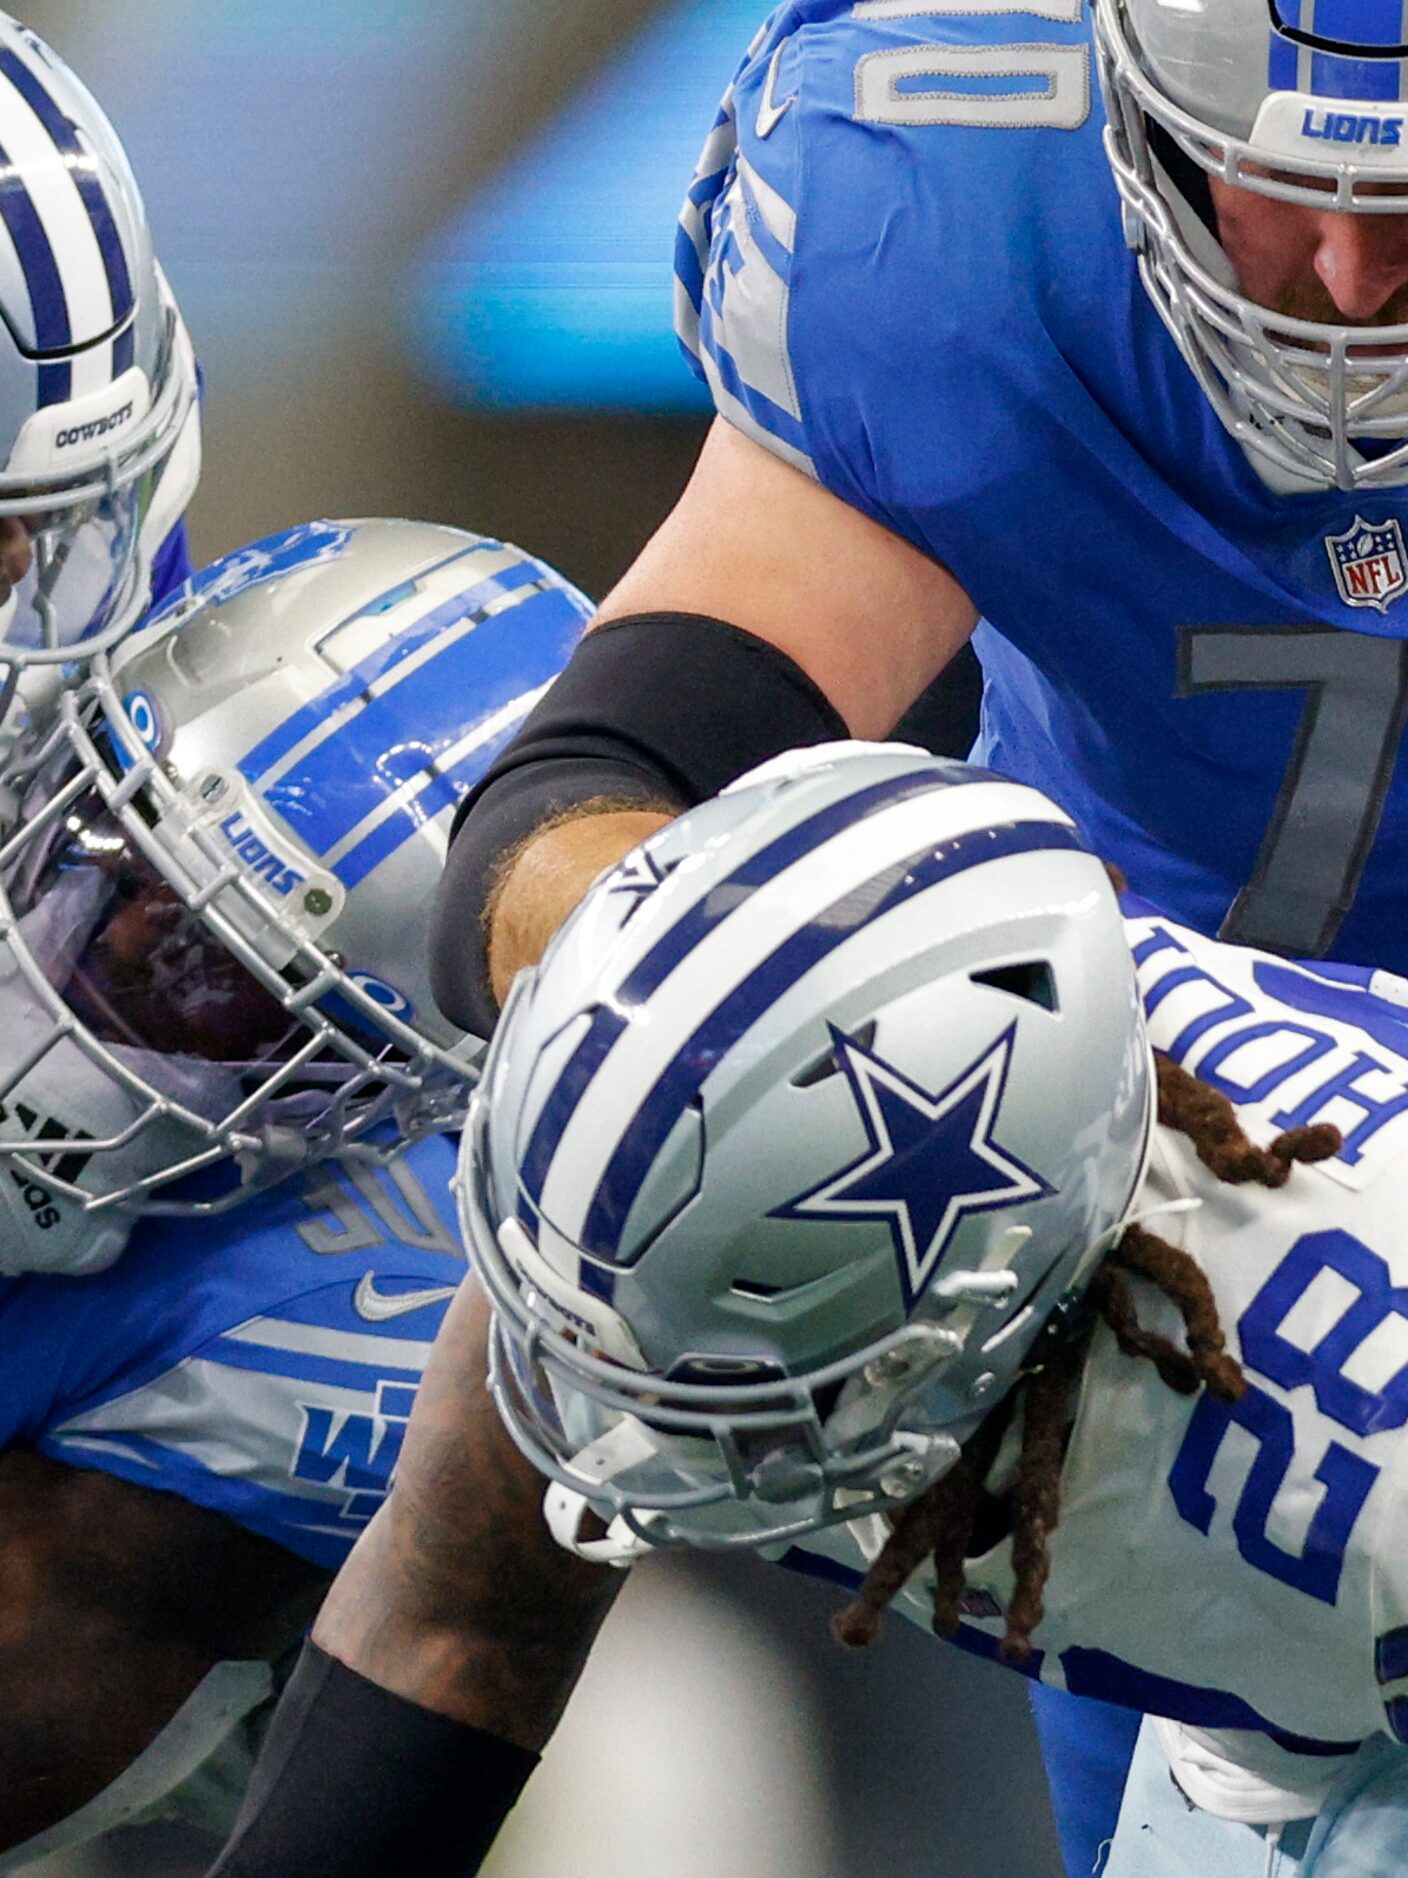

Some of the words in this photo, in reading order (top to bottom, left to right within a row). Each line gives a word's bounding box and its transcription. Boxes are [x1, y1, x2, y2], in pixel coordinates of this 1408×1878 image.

[1301, 108, 1405, 146] LIONS
[1344, 554, 1402, 595] NFL
[1176, 624, 1408, 959] 7
[219, 810, 306, 897] LIONS
[1167, 1227, 1408, 1607] 28
